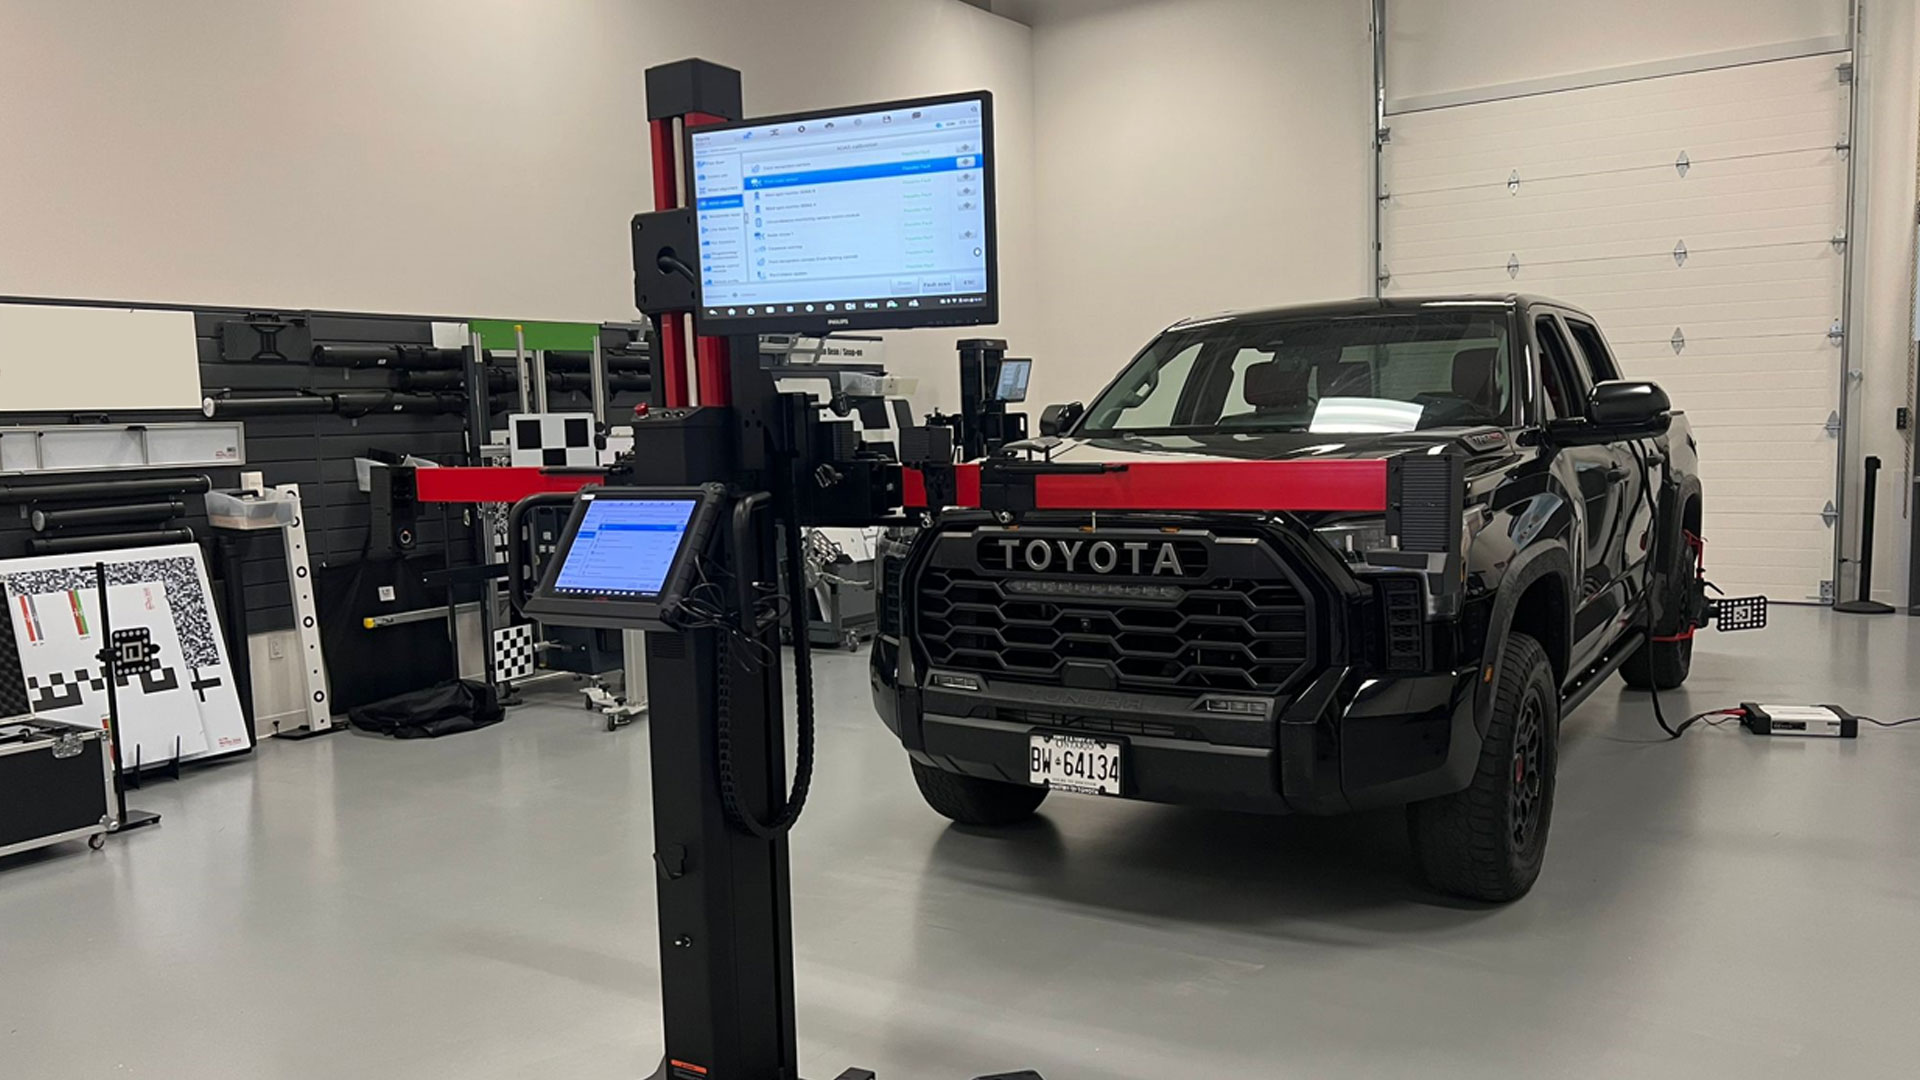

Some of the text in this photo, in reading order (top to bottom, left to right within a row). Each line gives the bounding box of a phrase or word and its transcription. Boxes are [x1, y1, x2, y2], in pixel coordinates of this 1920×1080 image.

[998, 538, 1184, 576] TOYOTA
[1031, 746, 1119, 783] BW 64134
